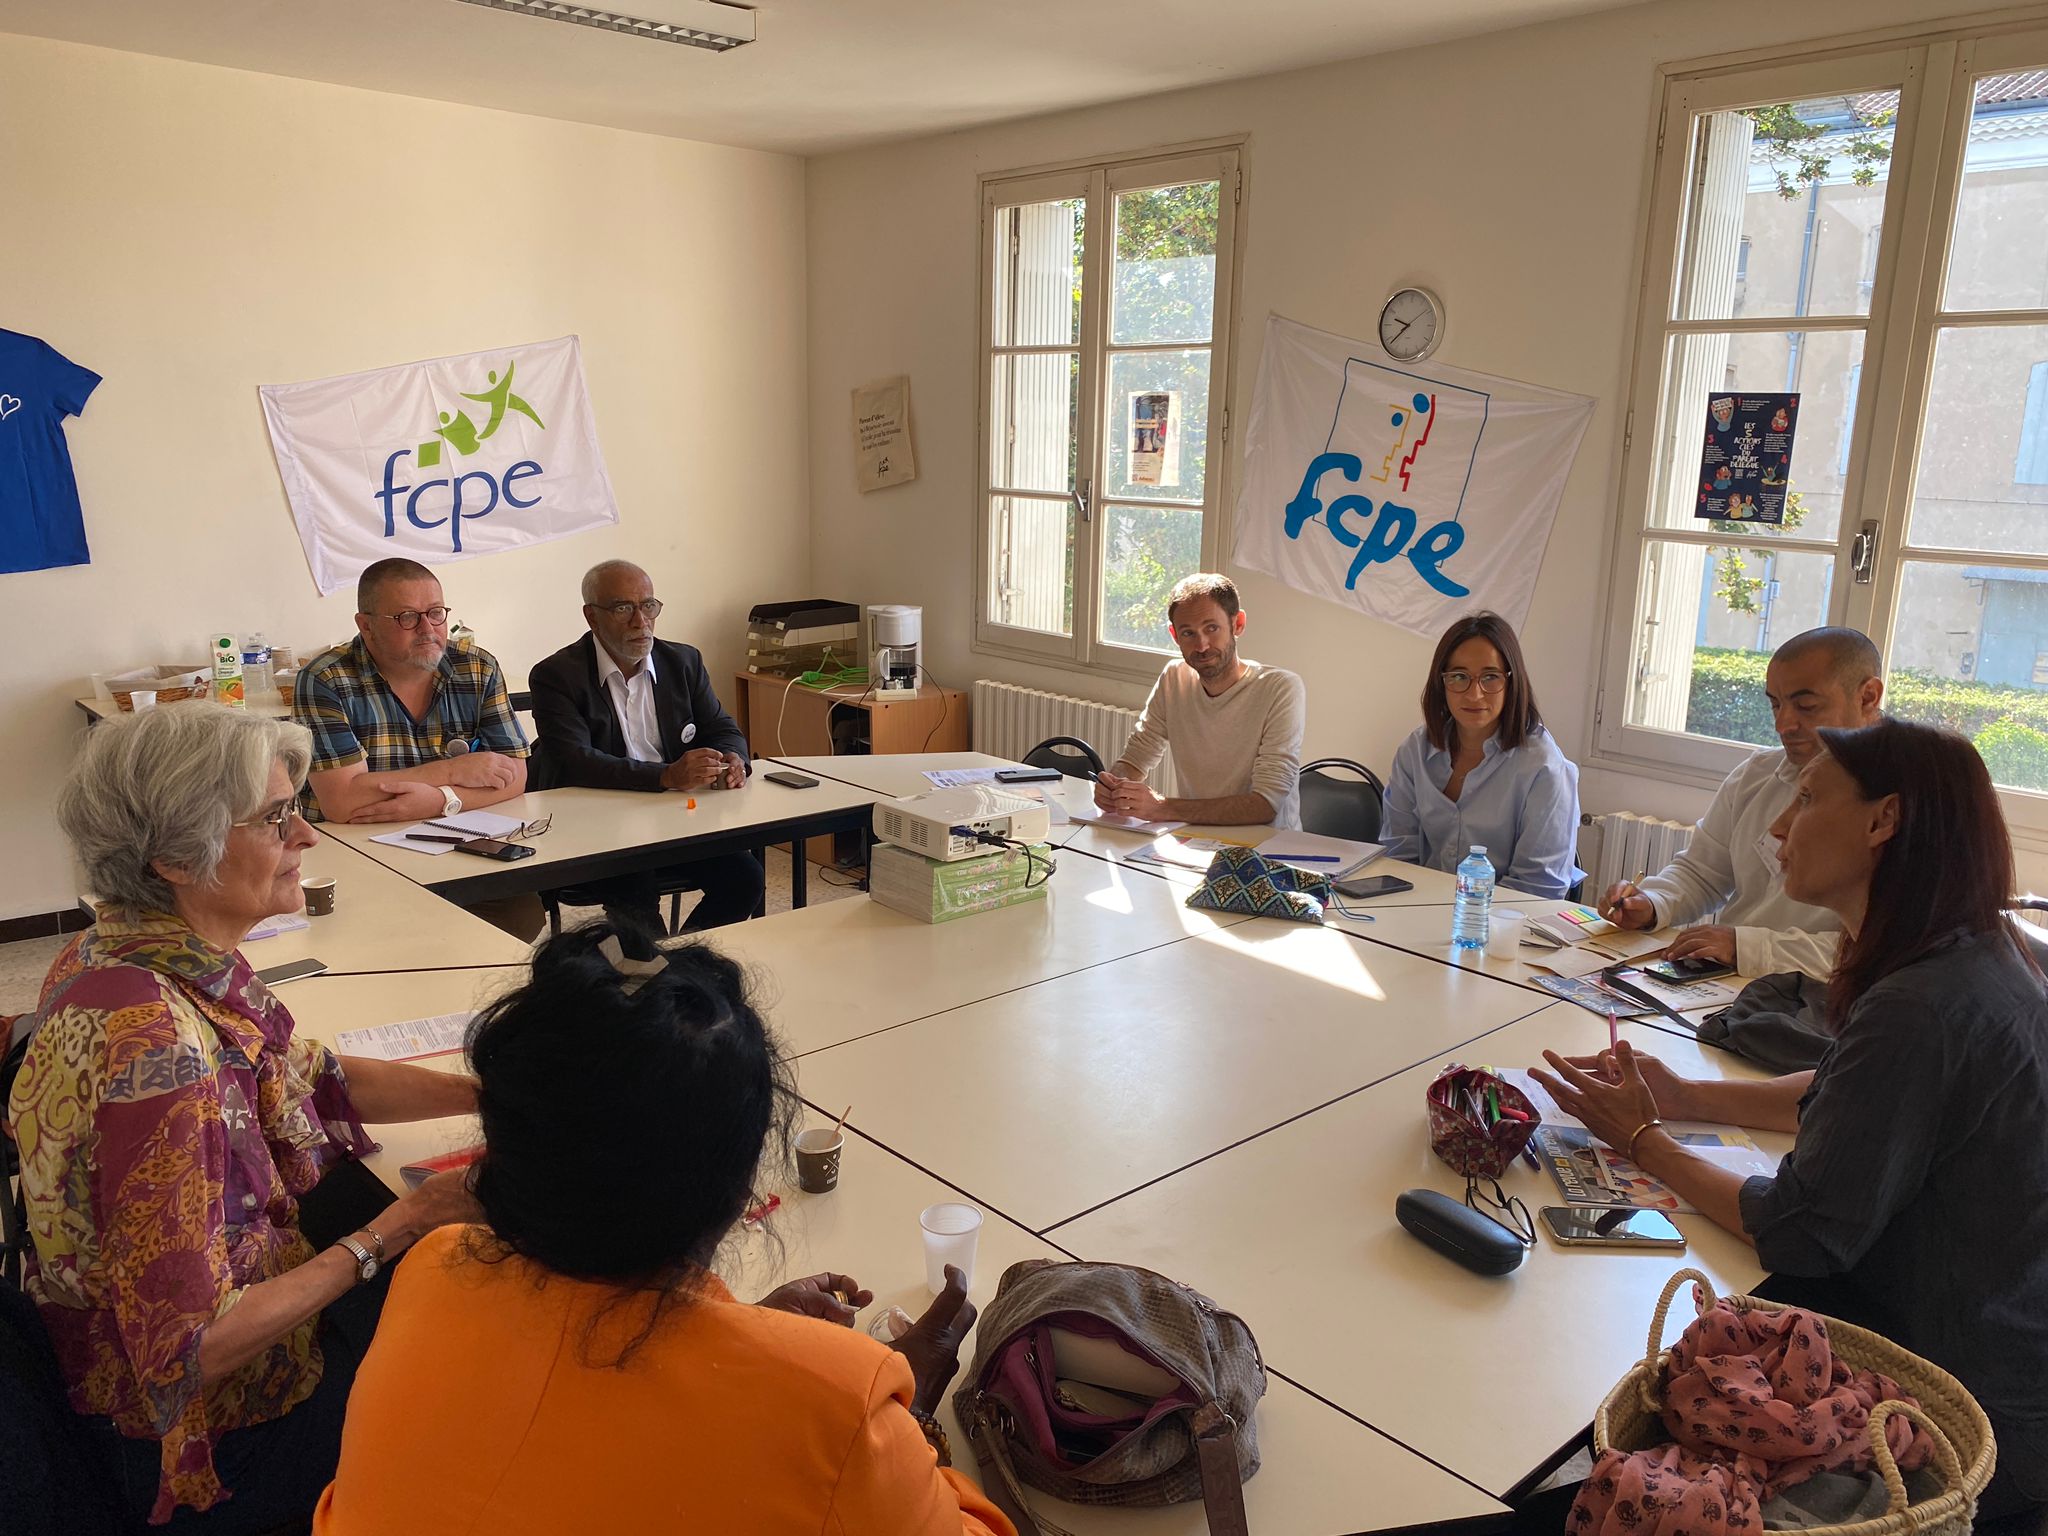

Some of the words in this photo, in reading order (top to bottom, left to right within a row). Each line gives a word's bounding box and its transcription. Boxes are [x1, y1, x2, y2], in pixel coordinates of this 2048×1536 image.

[1733, 436, 1762, 445] ACTIONS
[374, 449, 544, 553] fcpe
[1284, 452, 1470, 598] fcpe
